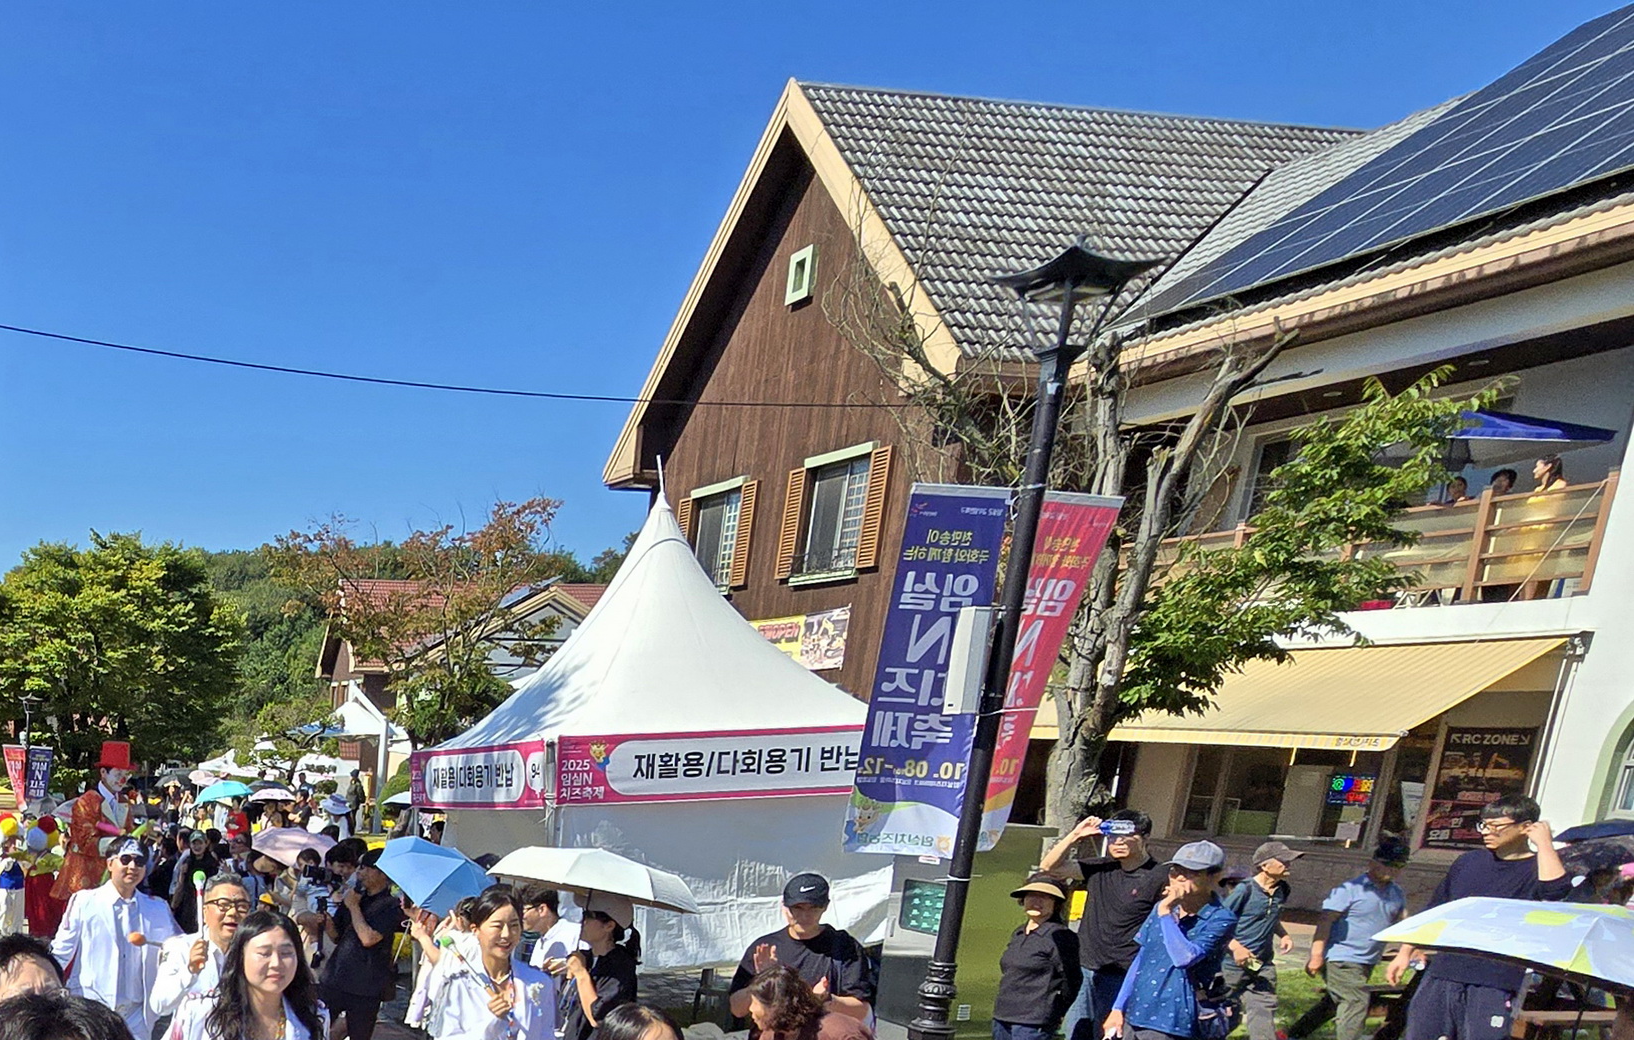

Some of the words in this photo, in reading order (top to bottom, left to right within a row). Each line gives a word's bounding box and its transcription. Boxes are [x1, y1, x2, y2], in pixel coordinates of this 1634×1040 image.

[1482, 734, 1520, 745] ZONE
[561, 759, 590, 771] 2025
[632, 746, 812, 779] 재활용/다회용기
[495, 761, 515, 788] 반납
[559, 786, 605, 801] 치즈축제
